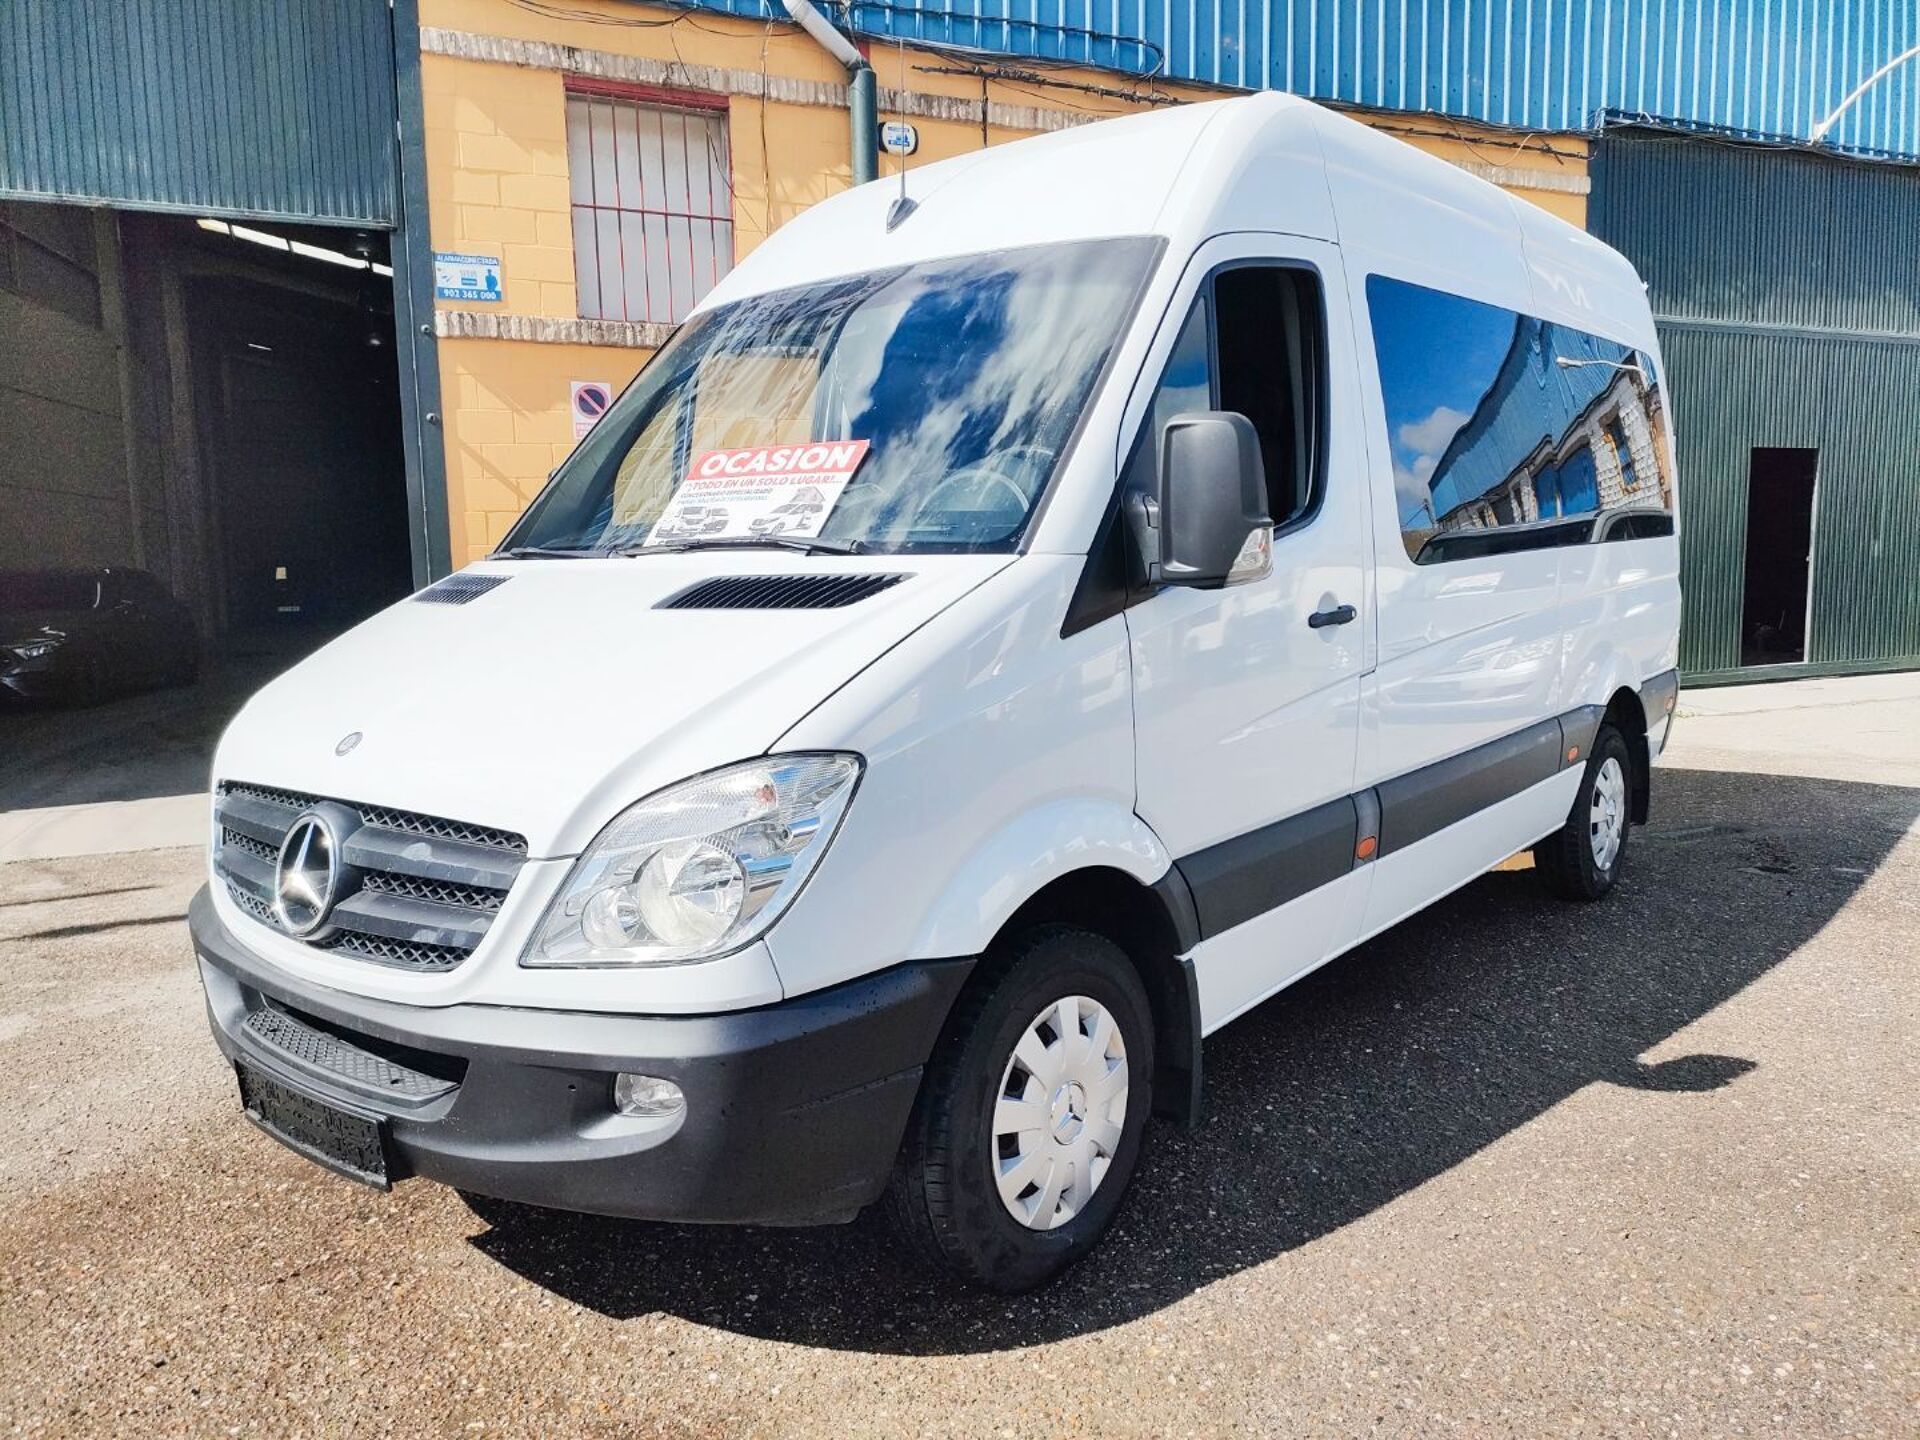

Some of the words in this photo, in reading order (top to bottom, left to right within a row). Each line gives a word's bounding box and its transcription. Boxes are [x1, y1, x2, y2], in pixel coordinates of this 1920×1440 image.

[443, 288, 461, 298] 902
[462, 289, 478, 299] 365
[480, 291, 497, 300] 000
[700, 444, 857, 476] OCASION
[723, 479, 739, 489] EN
[740, 478, 755, 487] UN
[756, 476, 789, 487] SOLO
